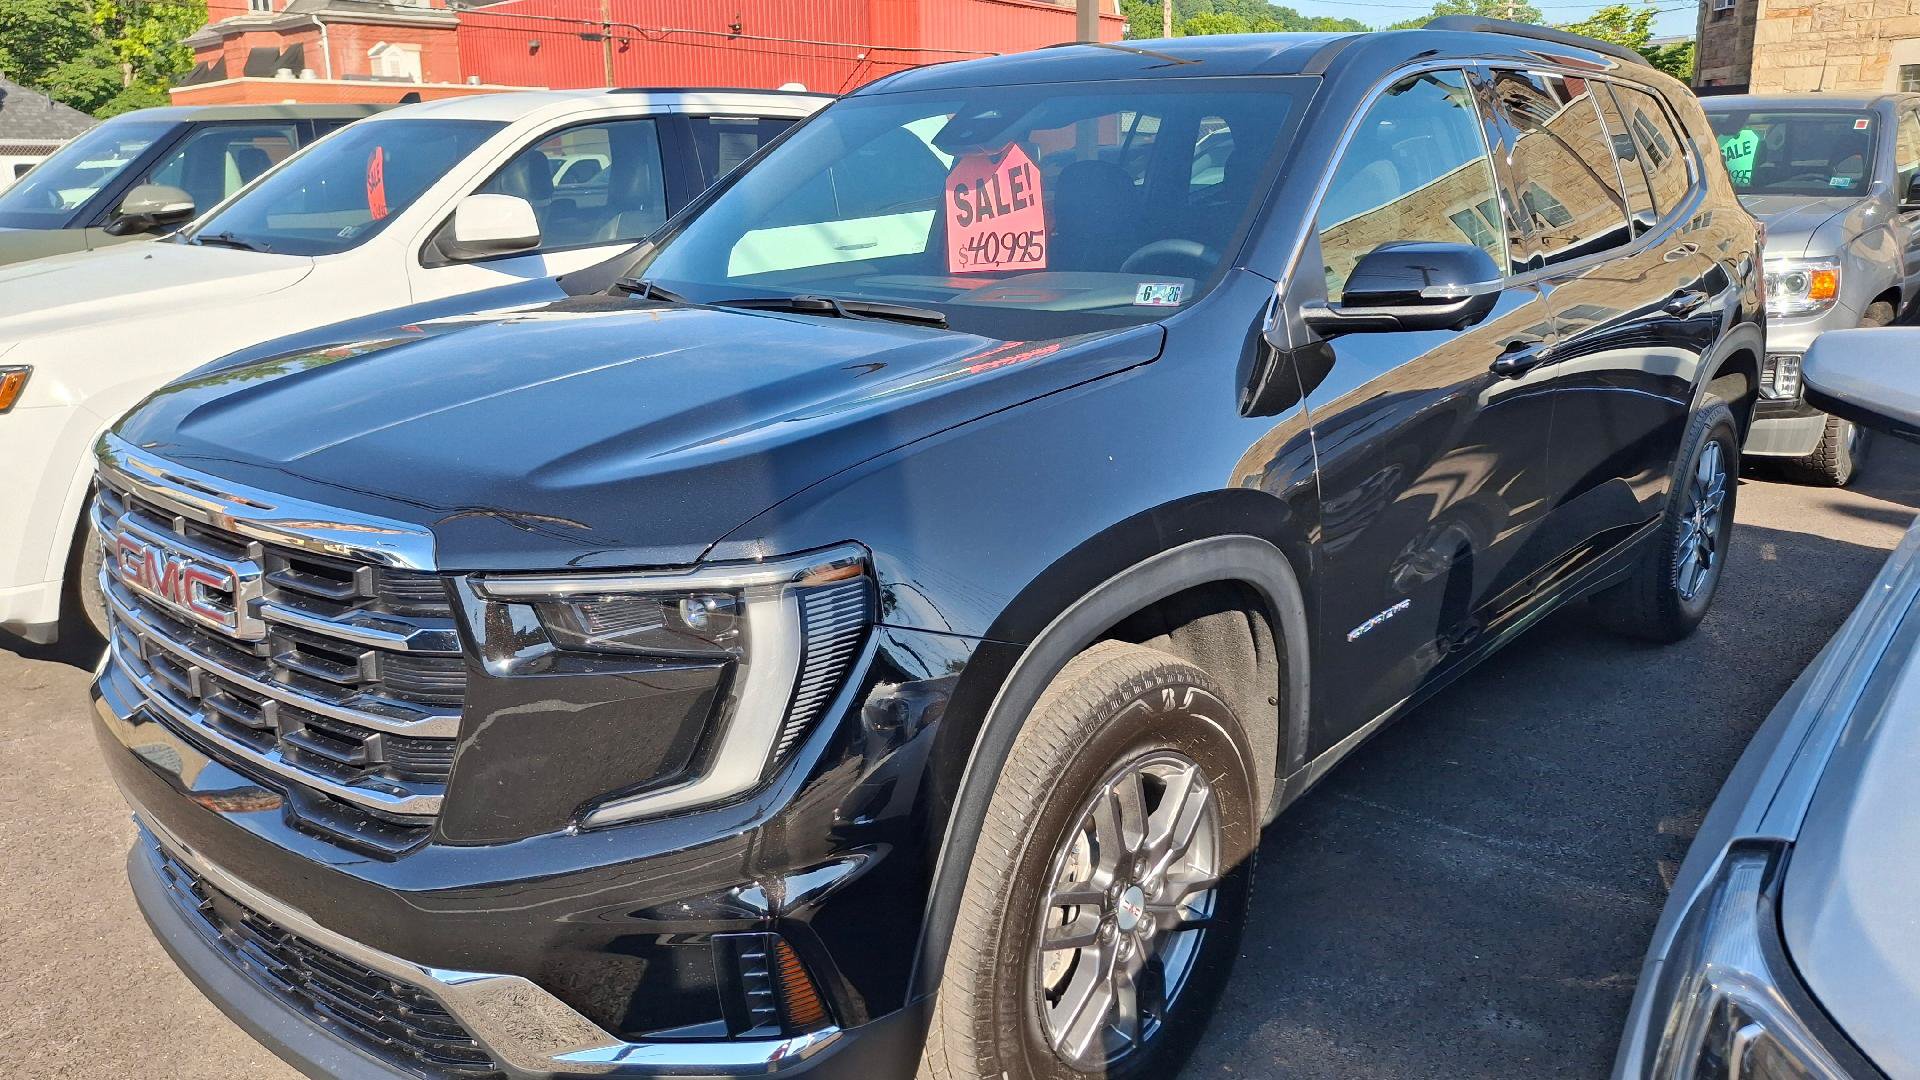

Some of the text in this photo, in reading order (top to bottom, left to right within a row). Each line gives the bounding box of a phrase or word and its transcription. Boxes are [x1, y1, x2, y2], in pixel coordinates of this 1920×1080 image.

[953, 163, 1035, 228] SALE!
[1729, 169, 1752, 185] 995
[958, 229, 1044, 268] $40,995
[1167, 286, 1181, 301] 26
[116, 531, 237, 627] GMC
